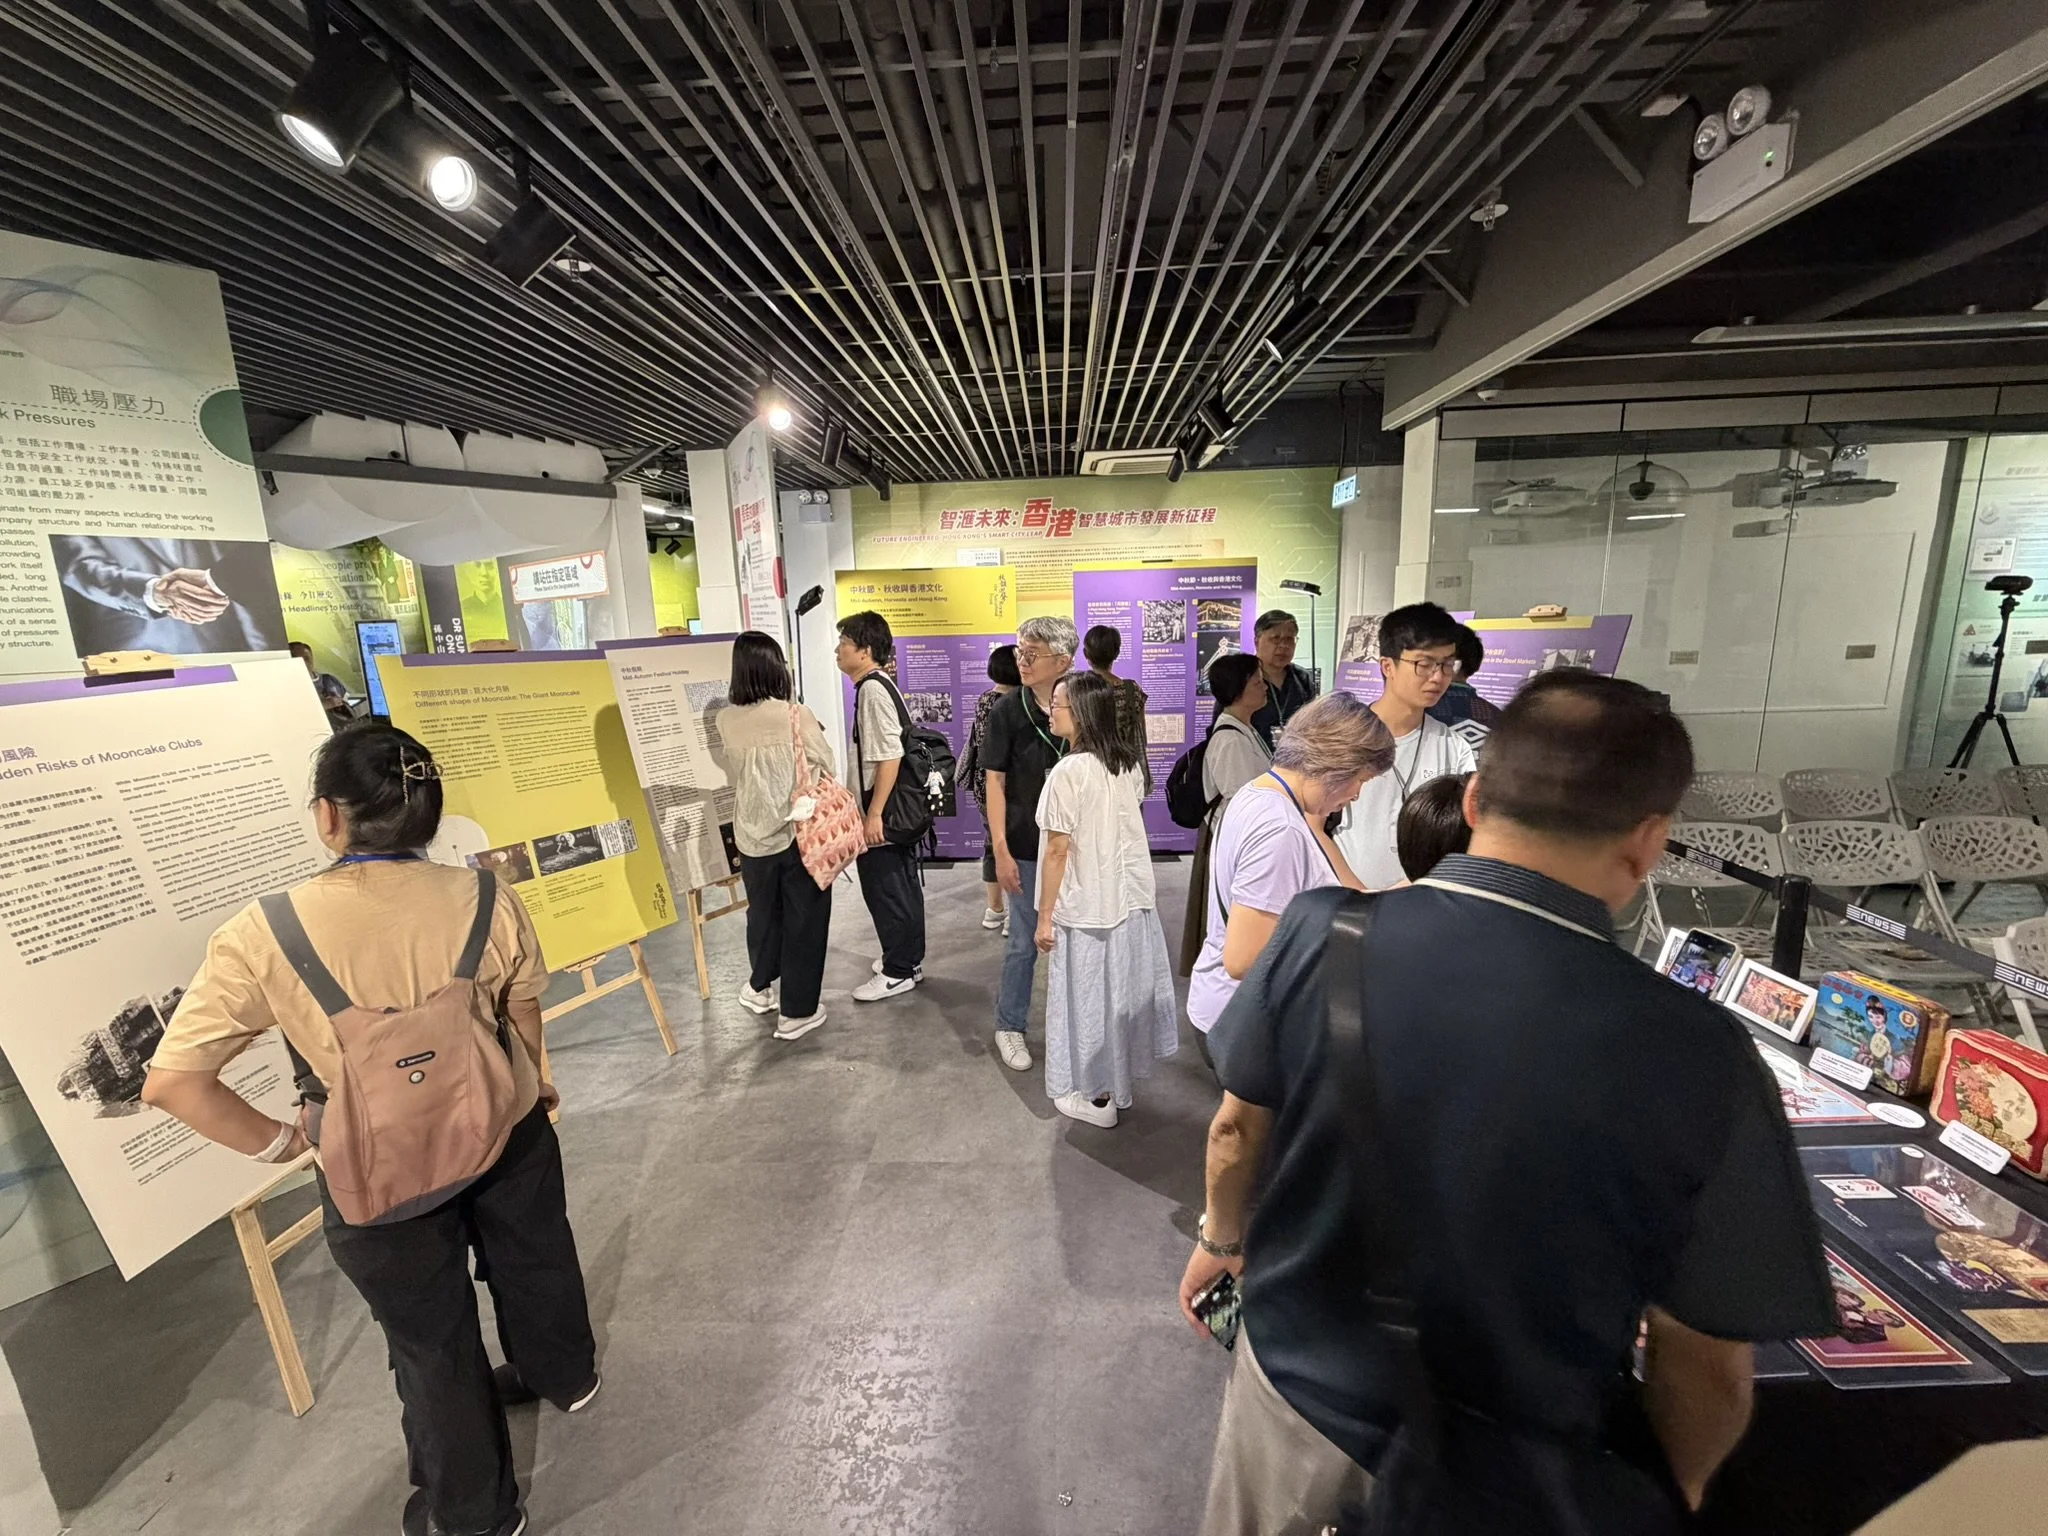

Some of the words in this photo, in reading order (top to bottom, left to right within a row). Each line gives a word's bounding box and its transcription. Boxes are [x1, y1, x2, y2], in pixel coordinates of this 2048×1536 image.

[49, 384, 165, 415] 職場壓力
[14, 409, 96, 428] Pressures
[29, 505, 51, 513] from
[55, 508, 80, 517] many
[85, 509, 120, 517] aspects
[123, 511, 162, 521] including
[181, 514, 213, 522] working
[38, 518, 80, 526] structure
[141, 522, 196, 531] relationships.
[24, 573, 46, 582] long
[850, 583, 944, 594] 中秋節、秋收與香港文化
[330, 604, 338, 612] to
[416, 700, 448, 708] Different
[0, 746, 37, 763] 風險
[36, 758, 78, 774] Risks
[81, 753, 95, 766] of
[98, 743, 166, 763] Mooncake
[169, 738, 203, 752] Clubs
